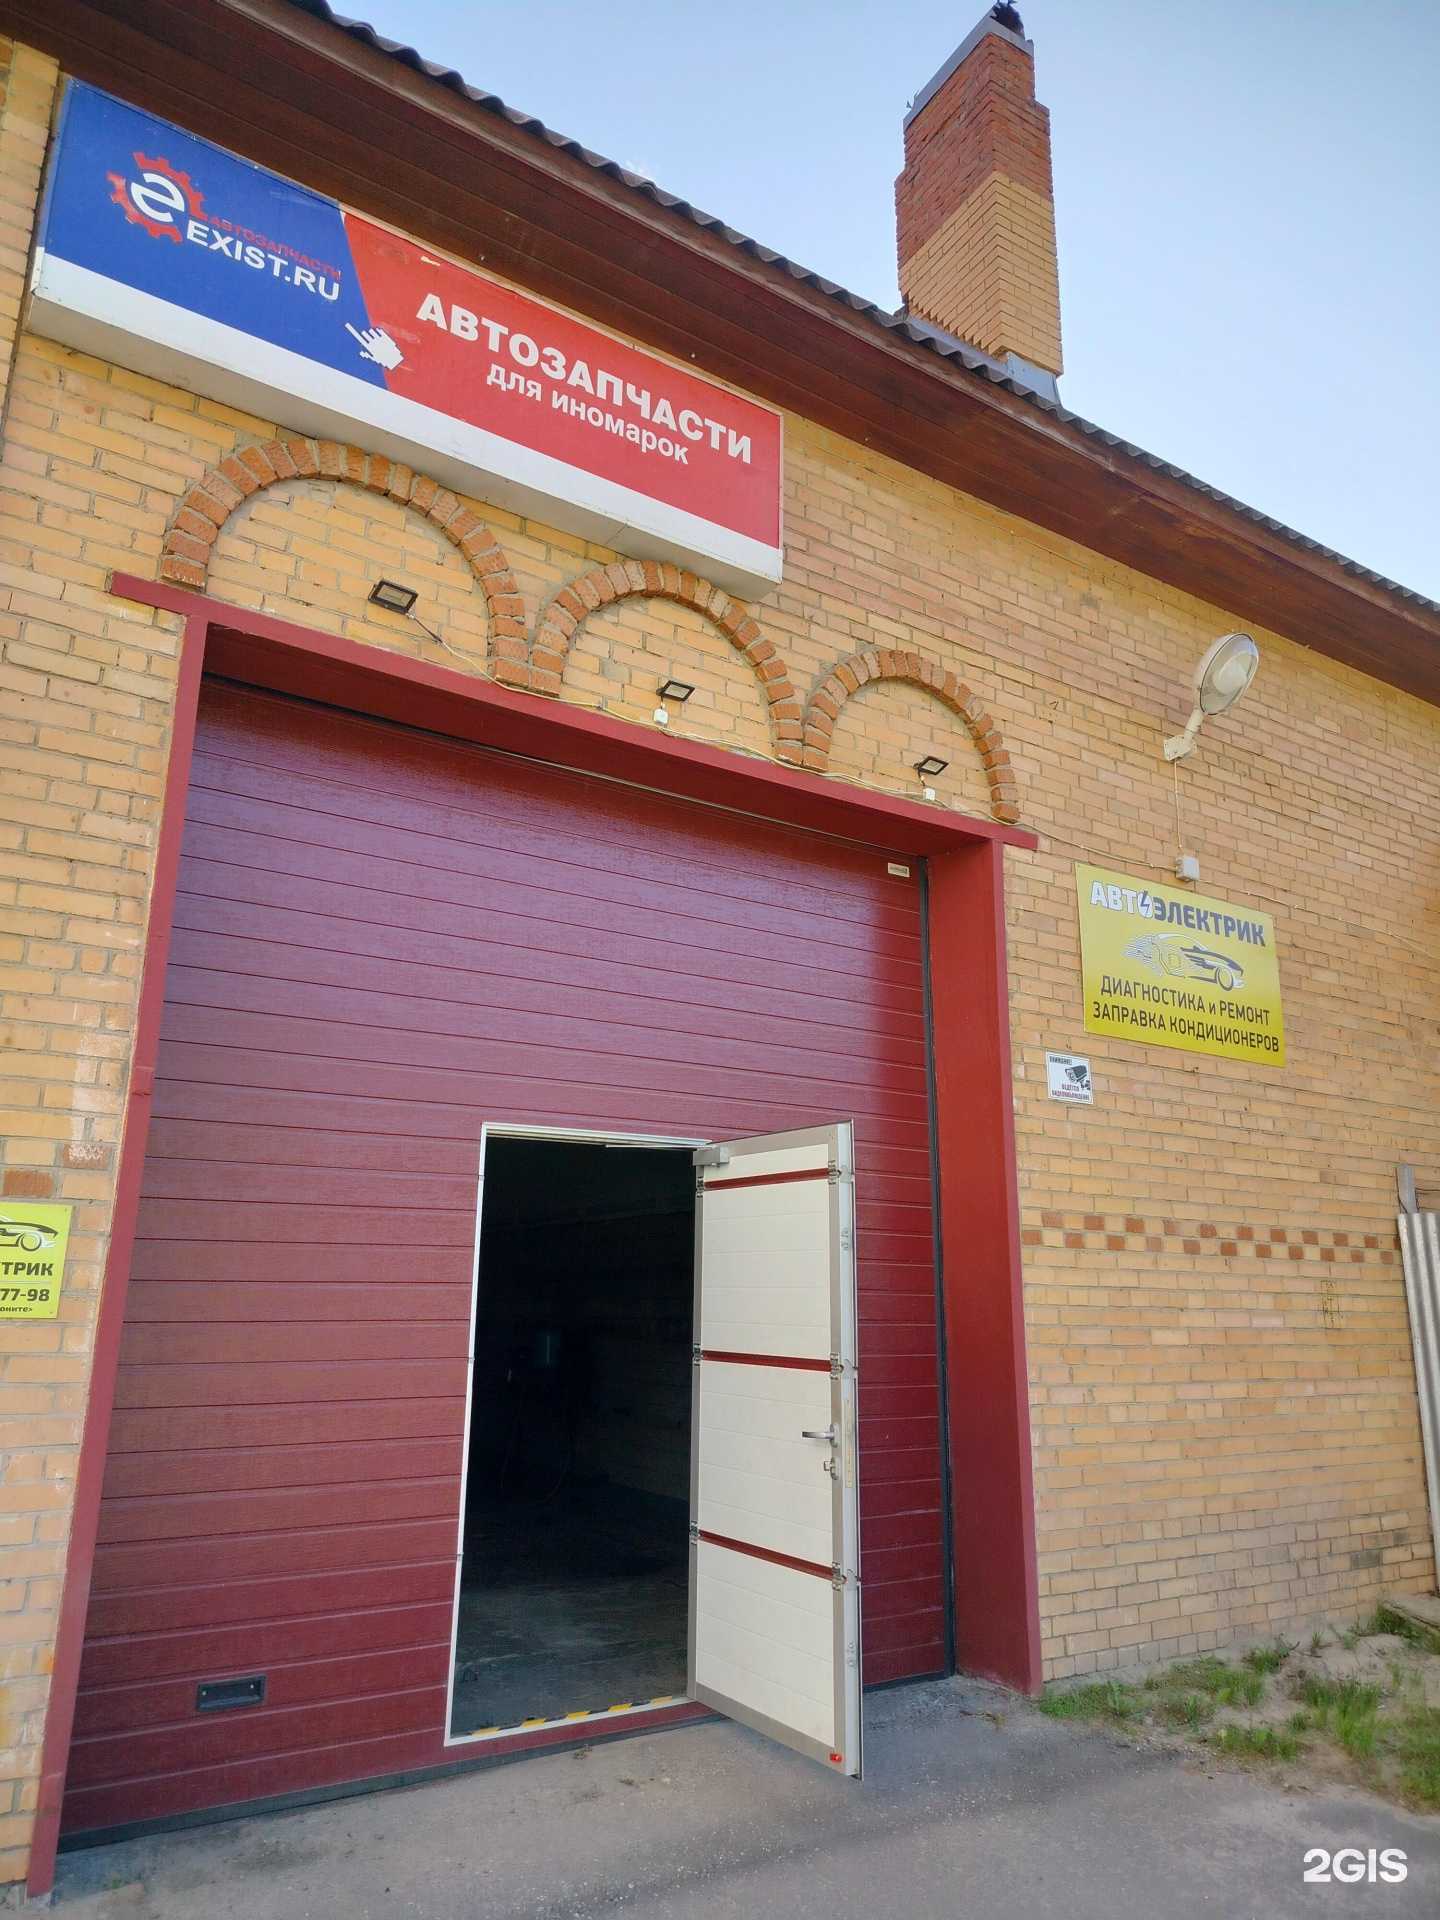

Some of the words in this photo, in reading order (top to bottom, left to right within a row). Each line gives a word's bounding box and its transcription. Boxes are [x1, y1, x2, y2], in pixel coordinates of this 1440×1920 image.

[187, 219, 340, 300] EXIST.RU
[416, 293, 752, 464] АВТОЗАПЧАСТИ
[487, 364, 542, 401] для
[552, 390, 689, 464] иномарок
[1090, 881, 1265, 946] АВТОЭЛЕКТРИК
[1093, 1001, 1166, 1030] ЗАПРАВКА
[1170, 1016, 1279, 1052] КОНДИЦИОНЕРОВ
[1101, 976, 1205, 1012] ДИАГНОСТИКА
[1209, 1003, 1215, 1015] и
[1220, 1000, 1270, 1025] РЕМОНТ
[0, 1262, 53, 1276] ТРИК
